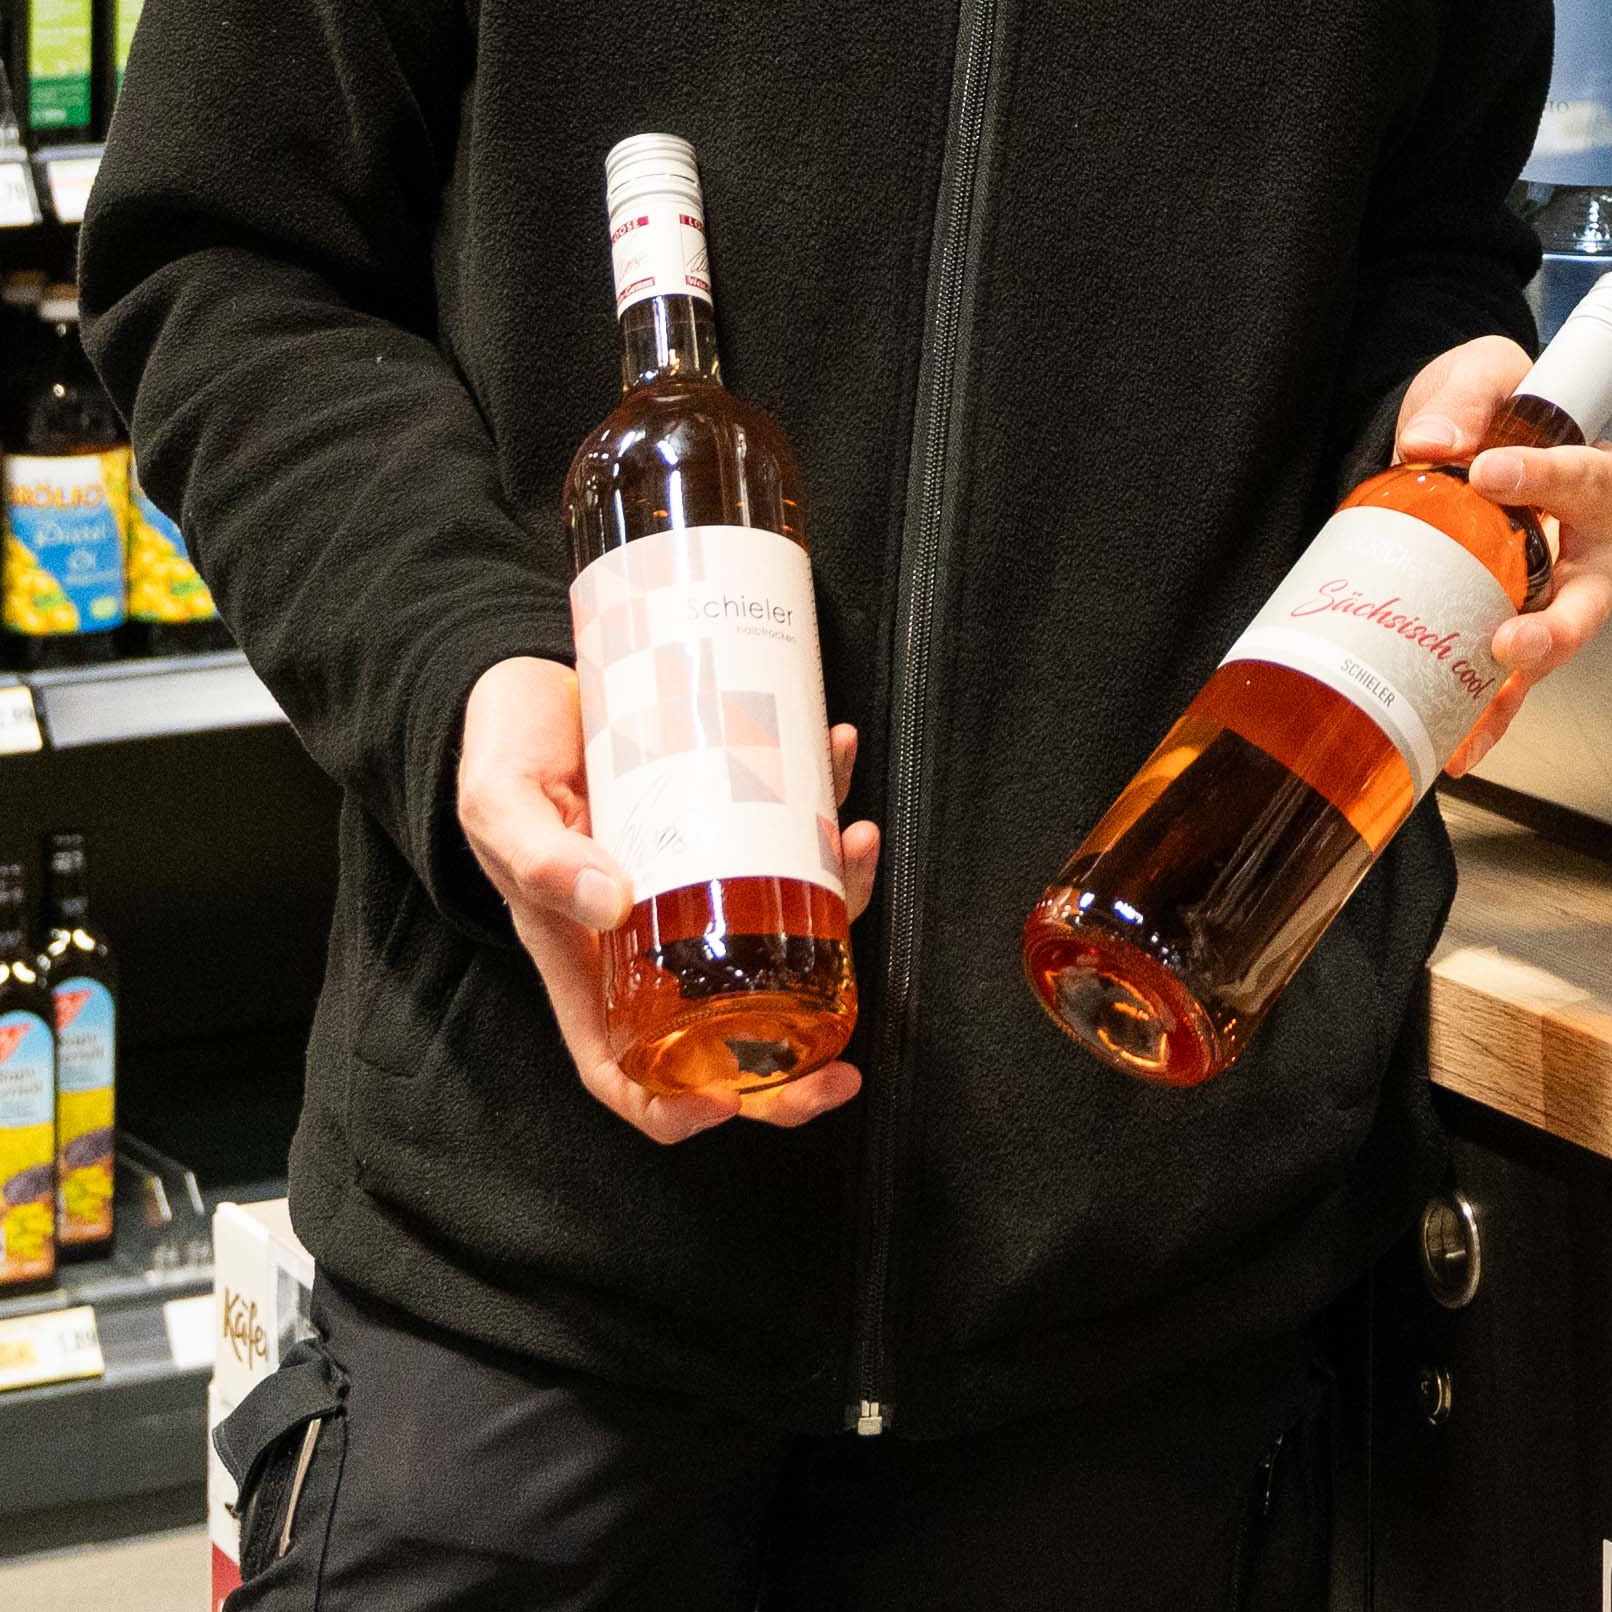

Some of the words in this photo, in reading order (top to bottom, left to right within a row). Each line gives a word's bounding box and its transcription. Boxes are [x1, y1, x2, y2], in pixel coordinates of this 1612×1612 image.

[687, 593, 793, 626] Schieler
[1290, 578, 1459, 661] Sächsisch
[1452, 658, 1495, 700] cool
[1340, 659, 1397, 708] SCHIELER
